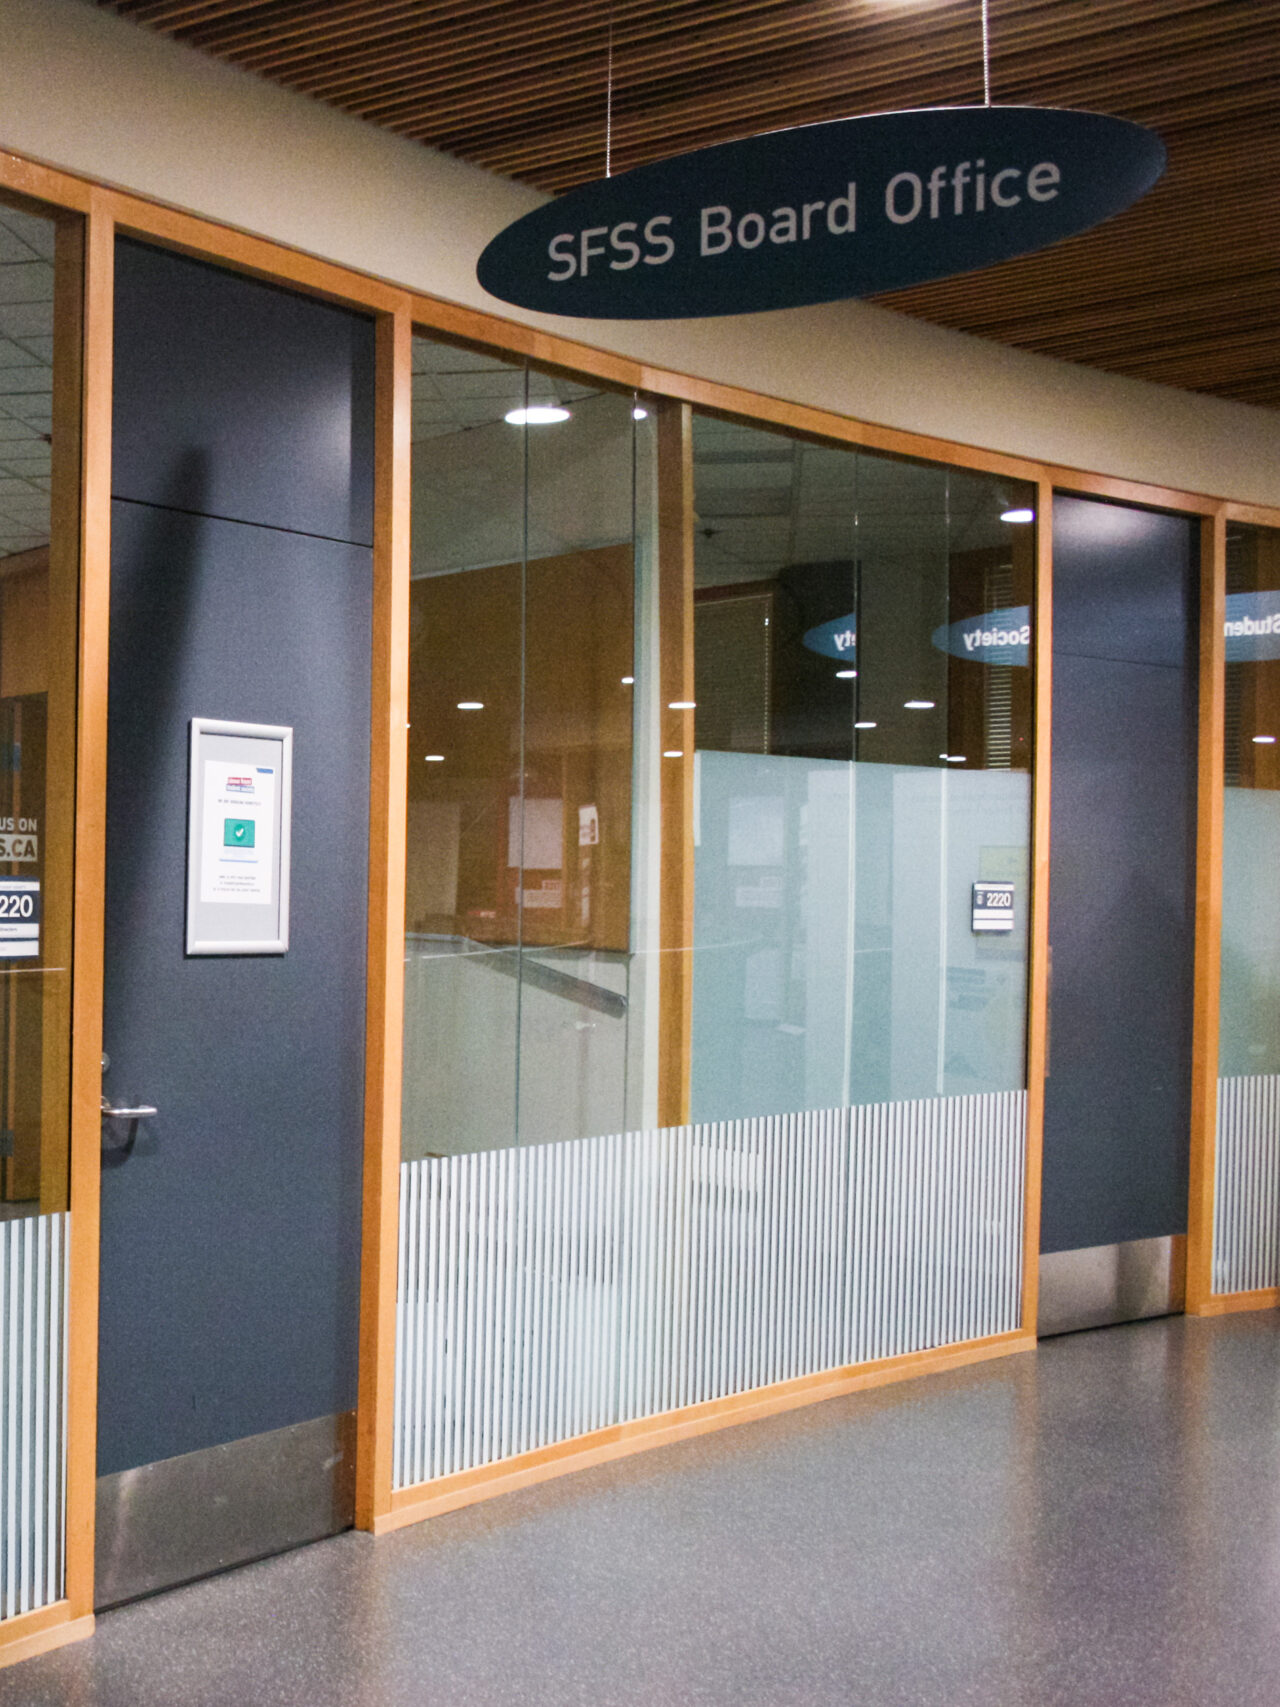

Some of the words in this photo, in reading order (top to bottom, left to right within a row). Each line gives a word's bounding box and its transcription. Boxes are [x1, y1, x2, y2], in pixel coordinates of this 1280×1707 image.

[547, 215, 674, 282] SFSS
[699, 182, 857, 257] Board
[884, 159, 1061, 225] Office
[18, 818, 37, 832] ON
[986, 892, 1011, 907] 2220
